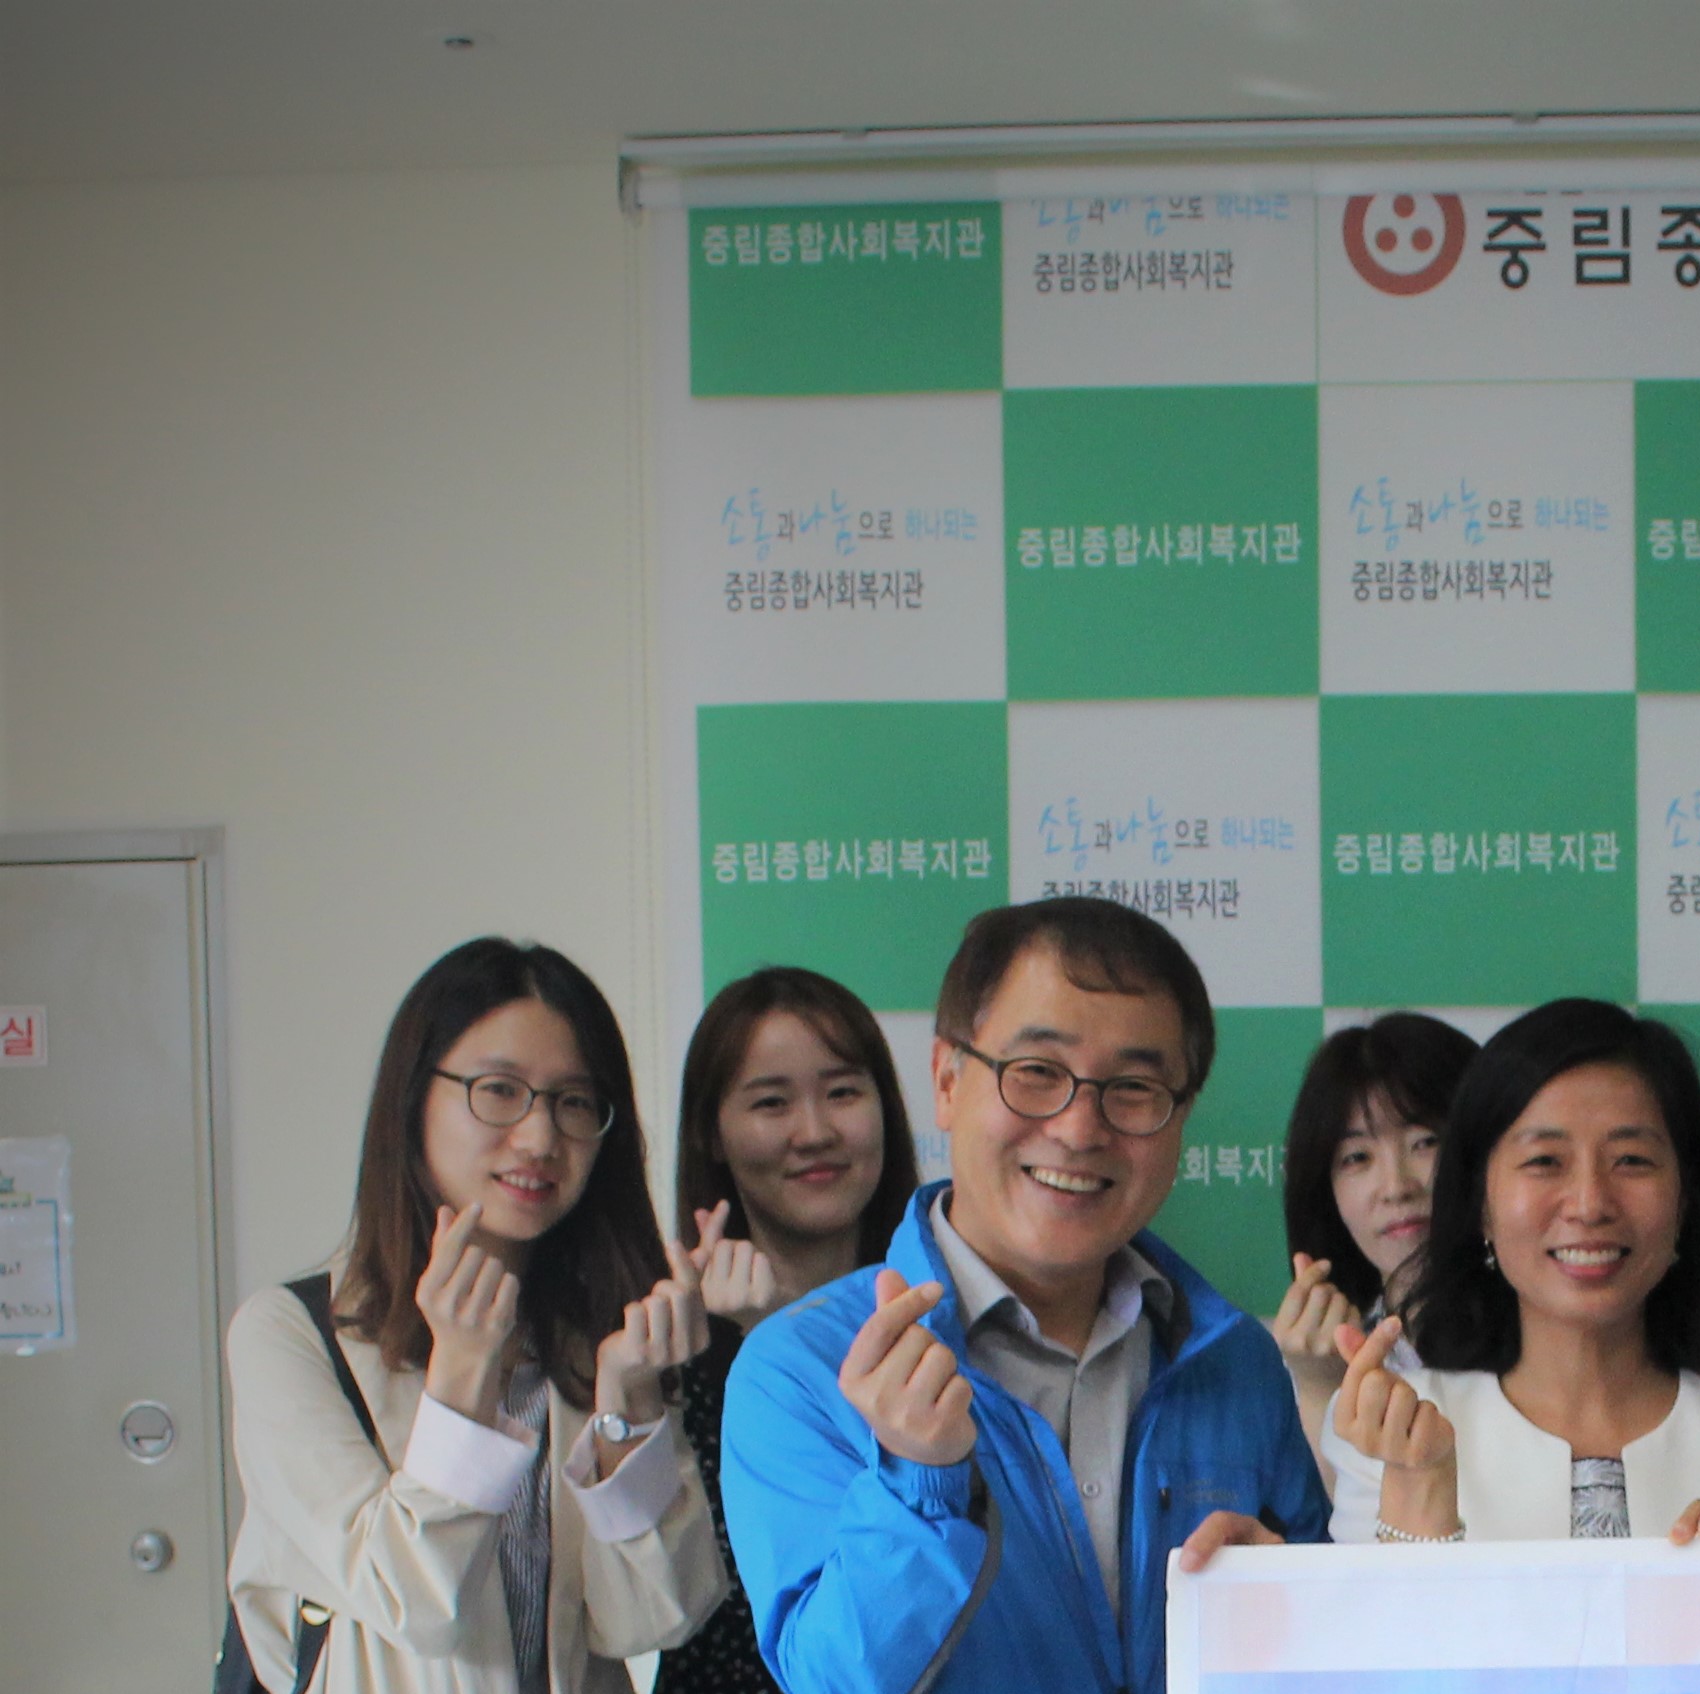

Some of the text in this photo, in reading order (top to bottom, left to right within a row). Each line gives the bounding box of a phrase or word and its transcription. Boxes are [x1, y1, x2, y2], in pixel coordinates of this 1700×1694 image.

[702, 219, 985, 266] 중림종합사회복지관
[1033, 250, 1234, 294] 중림종합사회복지관
[1017, 523, 1302, 570] 중림종합사회복지관
[724, 569, 924, 613] 중림종합사회복지관
[1351, 560, 1554, 603] 중림종합사회복지관
[712, 840, 993, 884] 중림종합사회복지관
[1333, 832, 1620, 875] 중림종합사회복지관
